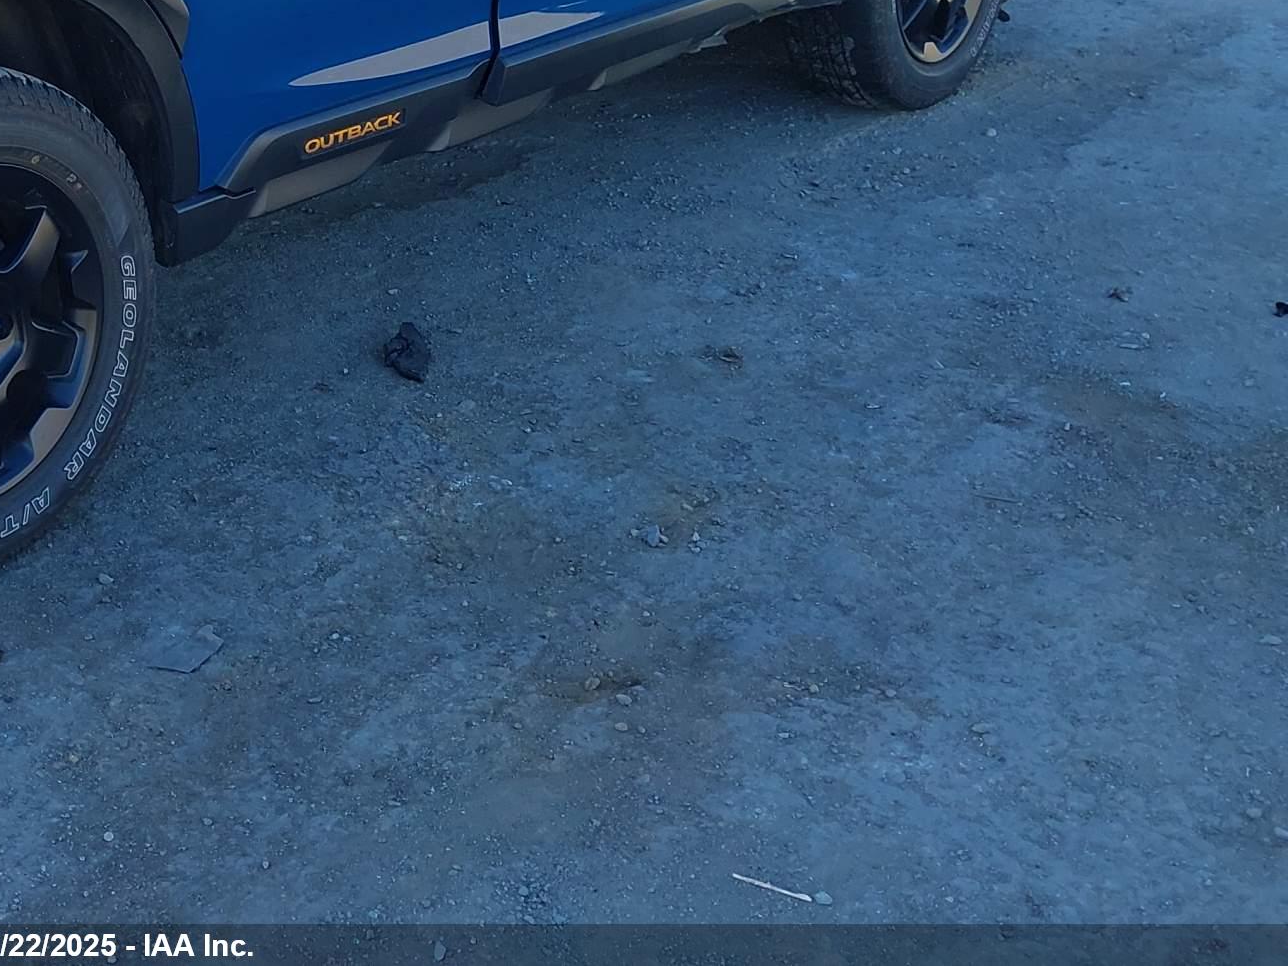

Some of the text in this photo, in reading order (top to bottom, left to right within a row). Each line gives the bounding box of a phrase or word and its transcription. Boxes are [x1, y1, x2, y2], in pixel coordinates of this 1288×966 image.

[304, 111, 401, 154] OUTBACK
[0, 254, 137, 538] GEOLANDAR A/T
